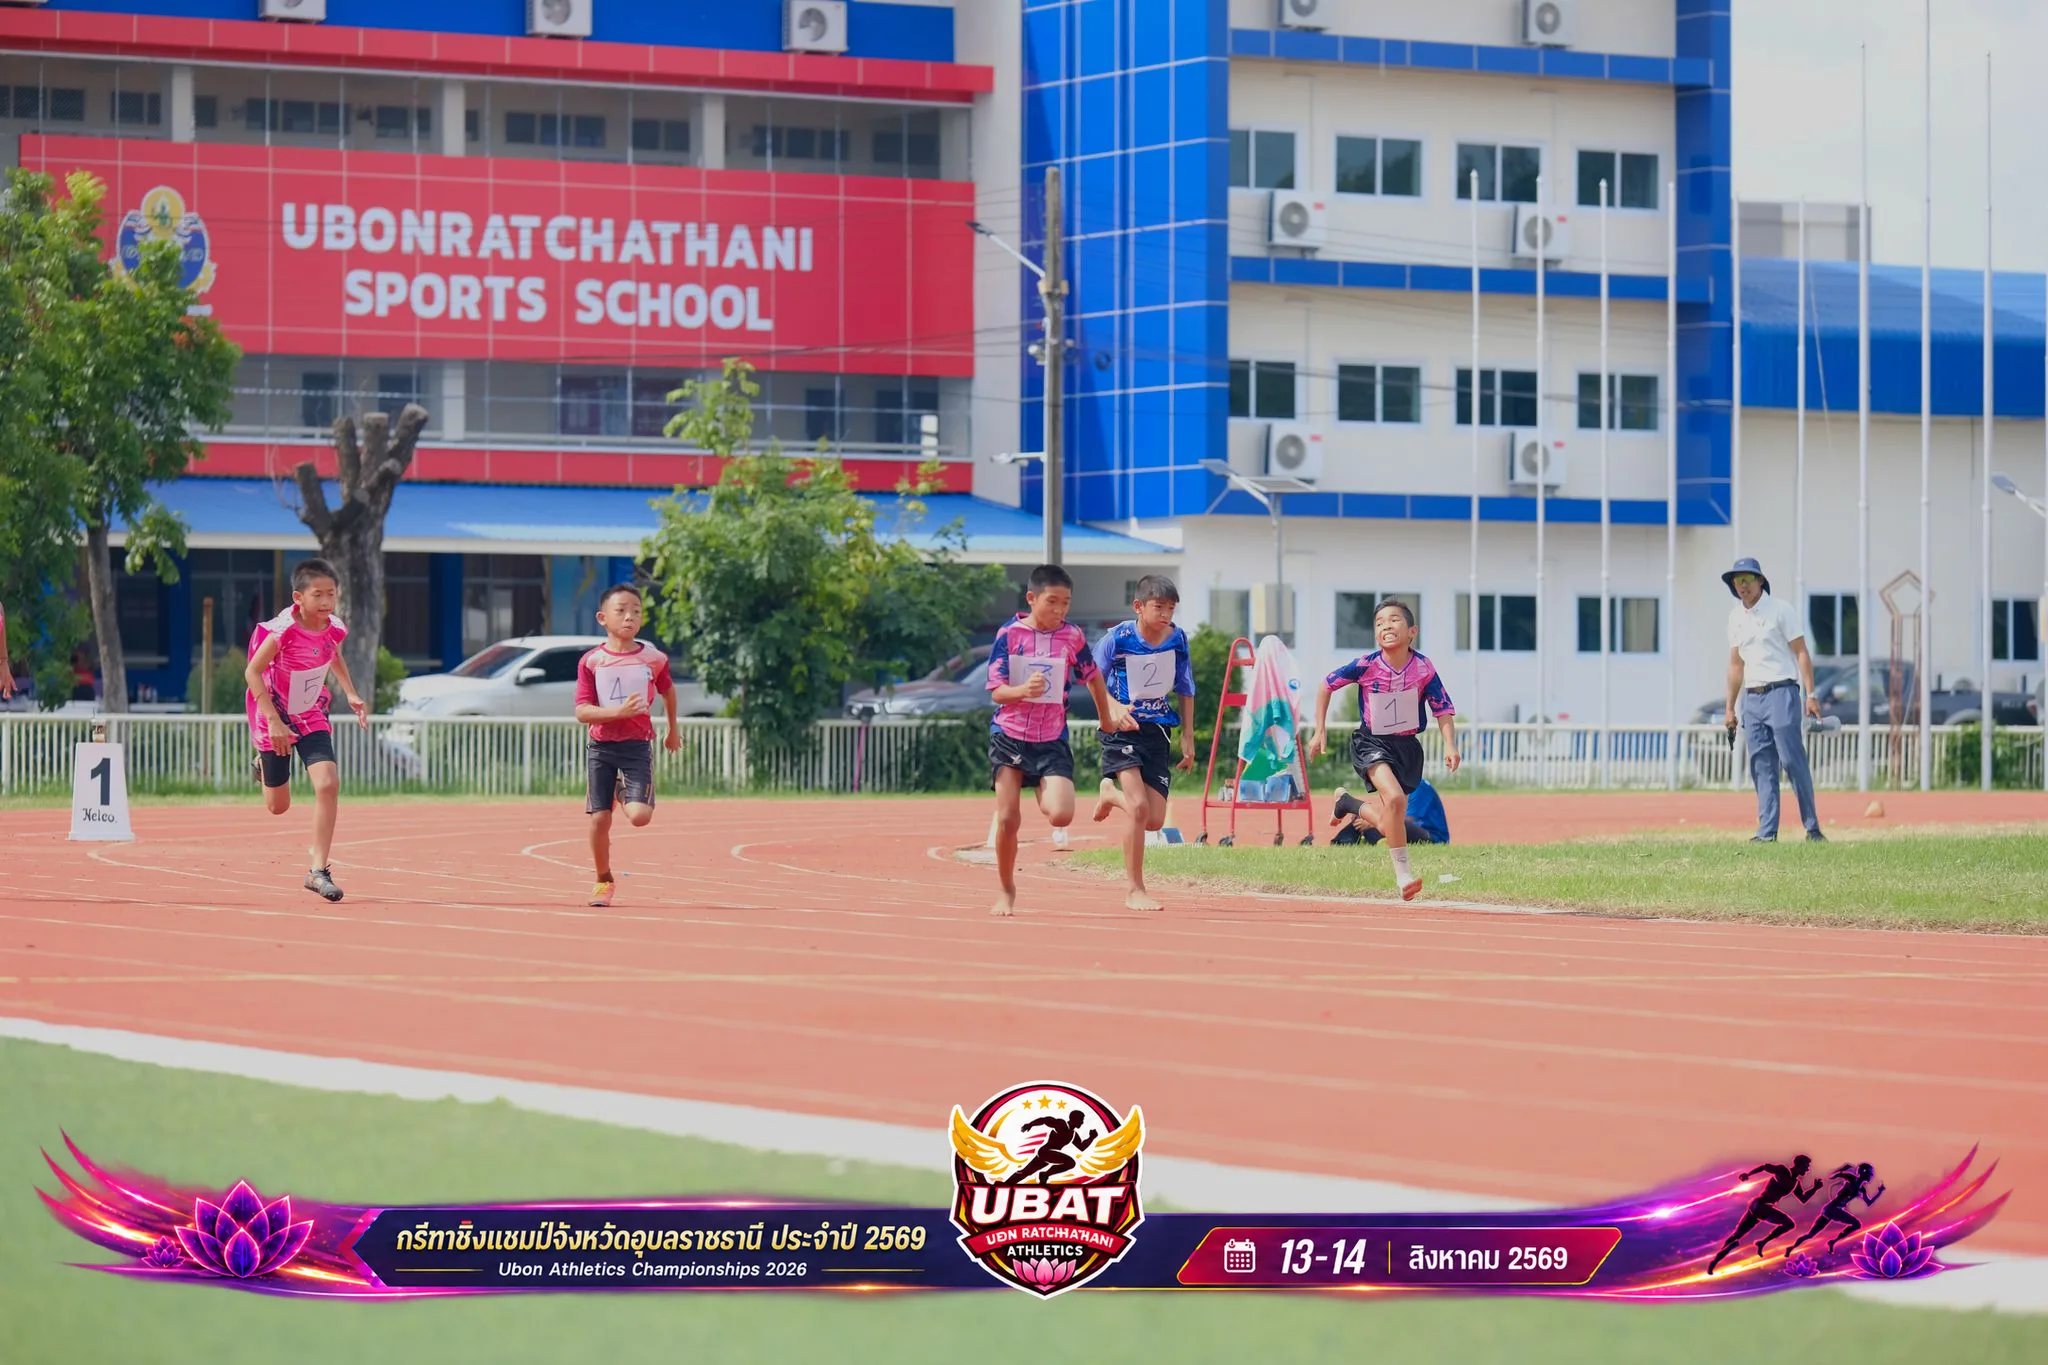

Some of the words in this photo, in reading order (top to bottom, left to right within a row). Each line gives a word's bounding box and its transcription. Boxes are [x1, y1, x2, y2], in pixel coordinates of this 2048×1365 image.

[282, 203, 813, 272] UBONRATCHATHANI
[344, 269, 547, 322] SPORTS
[575, 279, 774, 331] SCHOOL
[303, 675, 321, 705] 5
[609, 676, 628, 704] 4
[1142, 661, 1163, 688] 2
[1383, 697, 1408, 728] 1
[90, 757, 111, 806] 1
